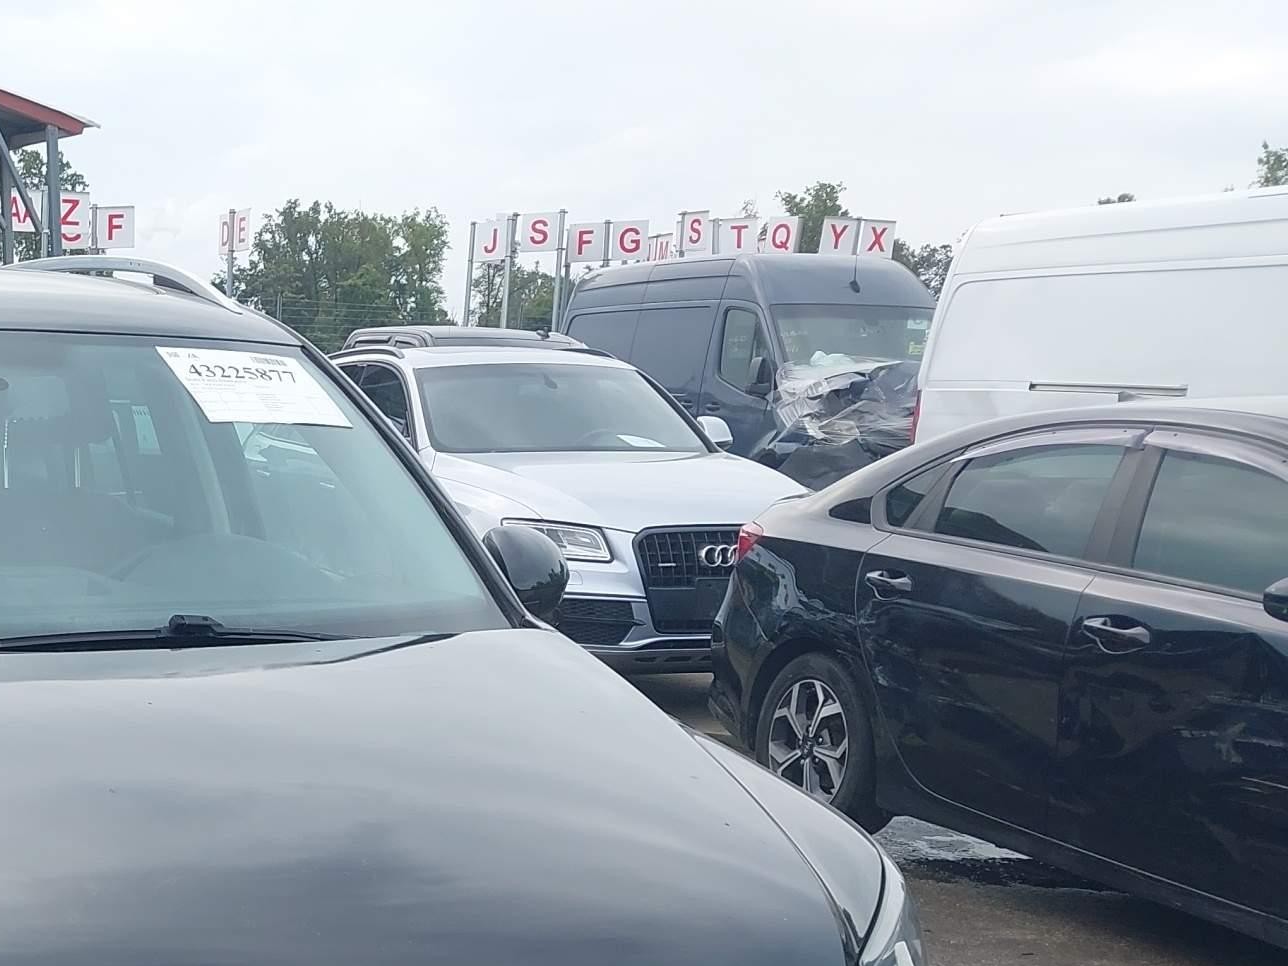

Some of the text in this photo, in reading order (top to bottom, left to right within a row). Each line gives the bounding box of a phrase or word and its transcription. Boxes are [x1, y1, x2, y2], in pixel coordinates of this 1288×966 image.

[59, 199, 81, 226] Z
[108, 214, 124, 240] F
[238, 217, 246, 243] E
[530, 220, 549, 245] S
[689, 218, 701, 244] S
[730, 225, 749, 249] T
[771, 223, 792, 250] Q
[830, 223, 849, 249] Y
[867, 226, 888, 252] X
[484, 228, 498, 253] J
[577, 230, 594, 256] F
[619, 228, 641, 254] G
[188, 363, 296, 384] 43225877
